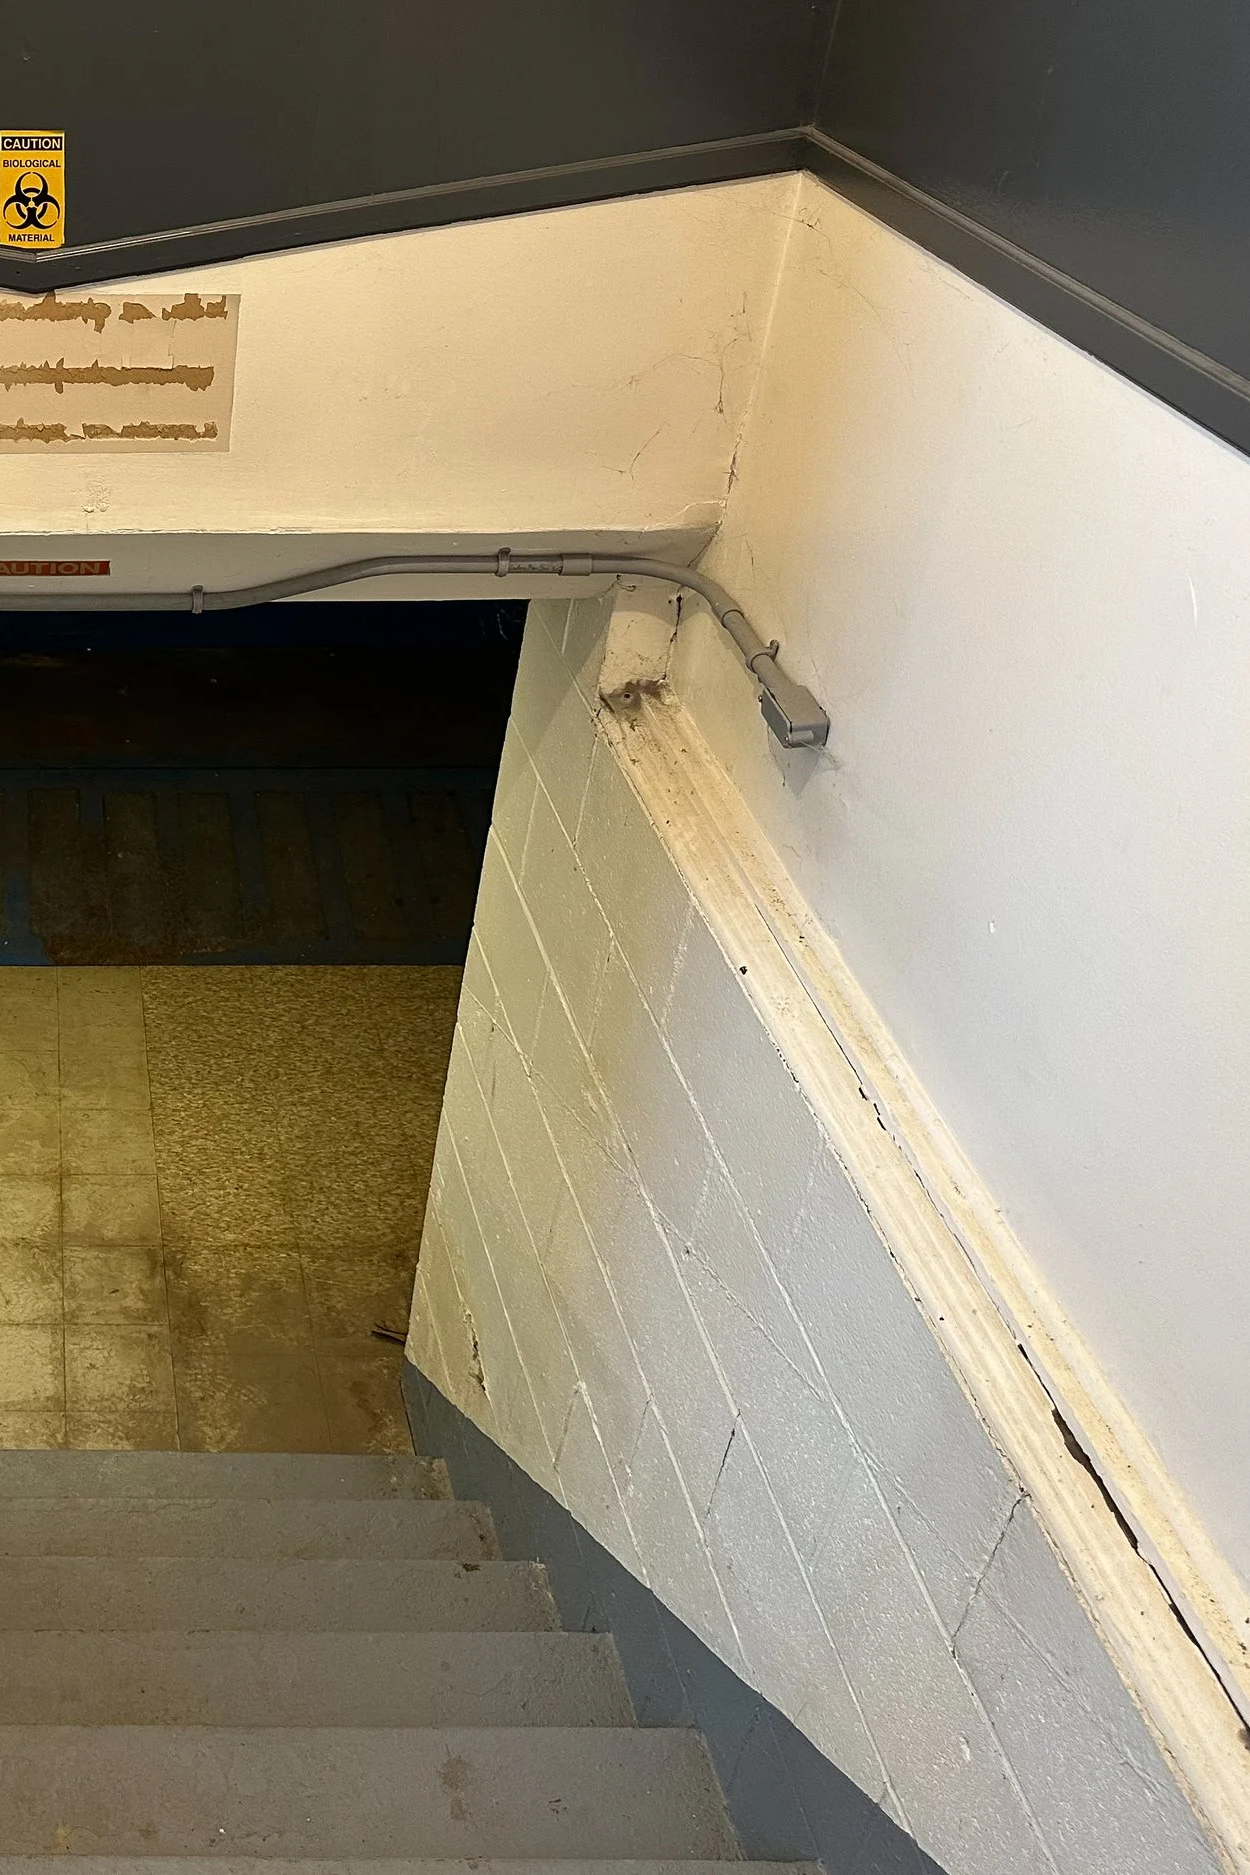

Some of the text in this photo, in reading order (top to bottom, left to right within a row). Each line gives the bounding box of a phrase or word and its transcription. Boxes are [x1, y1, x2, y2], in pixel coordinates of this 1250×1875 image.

[3, 138, 61, 149] CAUTION
[2, 160, 61, 168] BIOLOGICAL
[8, 234, 55, 242] MATERIAL
